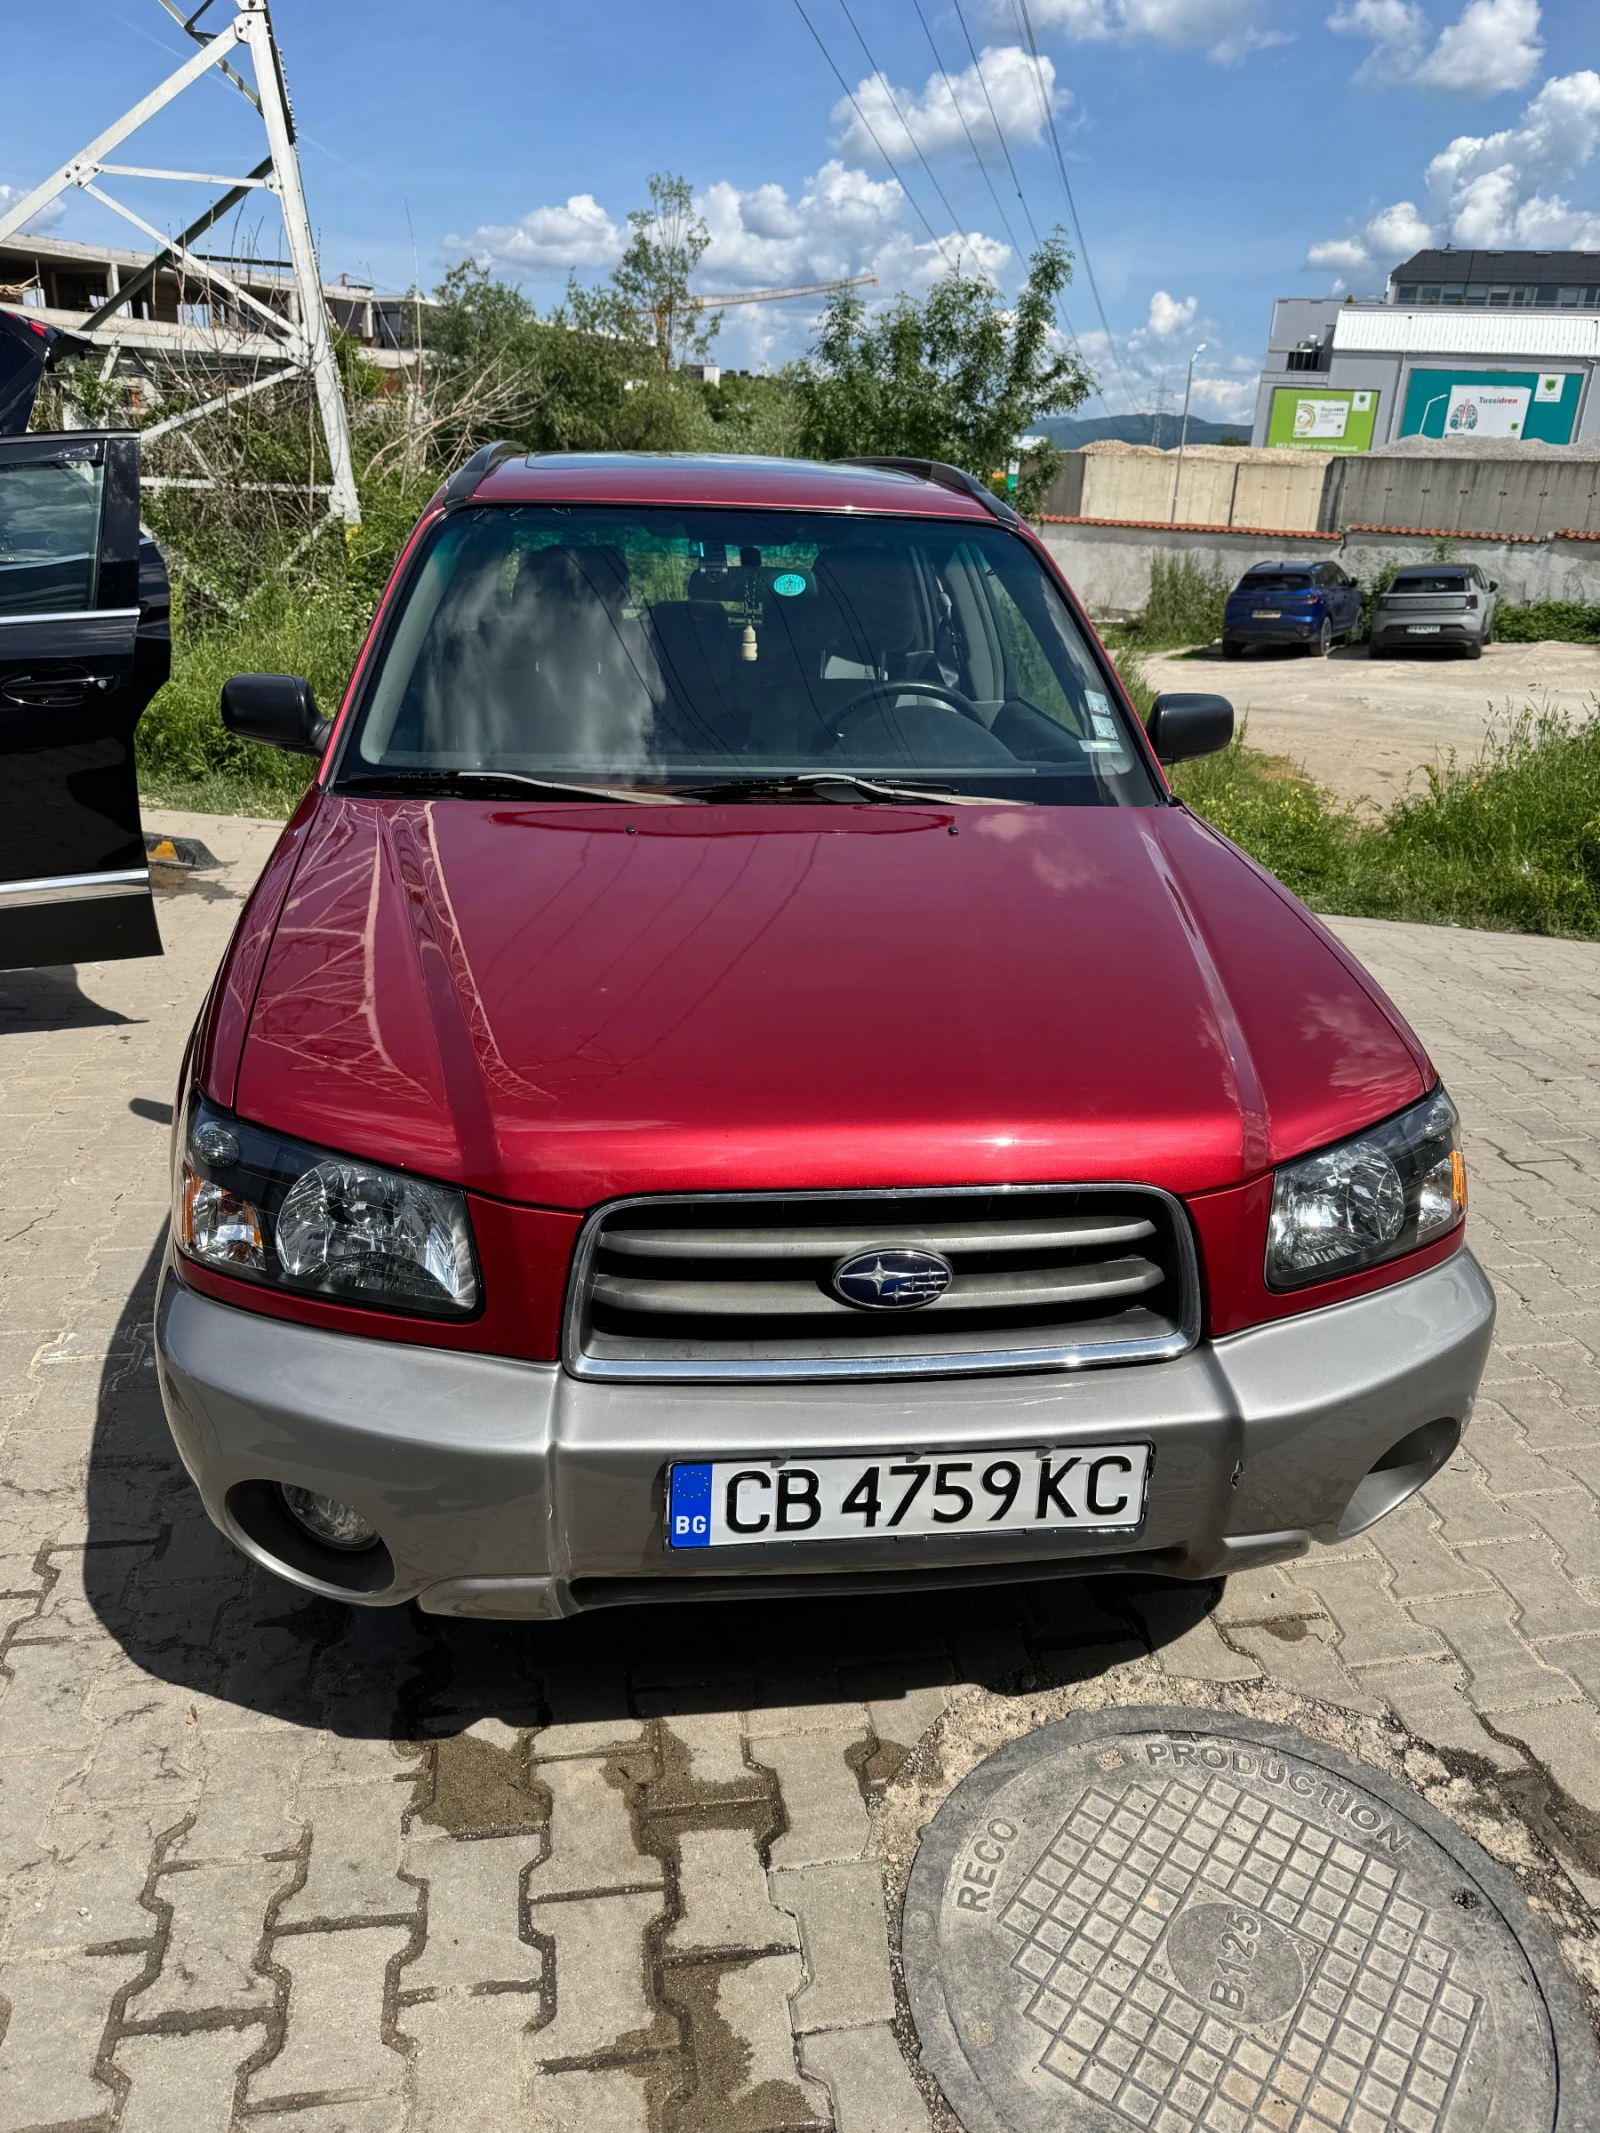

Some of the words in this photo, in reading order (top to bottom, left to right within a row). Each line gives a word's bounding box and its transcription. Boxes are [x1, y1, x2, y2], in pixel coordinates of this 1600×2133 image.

[1479, 396, 1518, 404] Tussidren
[675, 1514, 707, 1535] BG
[725, 1468, 822, 1534] CB
[841, 1461, 1022, 1528] 4759
[1035, 1455, 1132, 1519] KC
[956, 1816, 1019, 1913] RECO
[1144, 1742, 1412, 1853] PRODUCTION
[1209, 1910, 1263, 2012] B125
